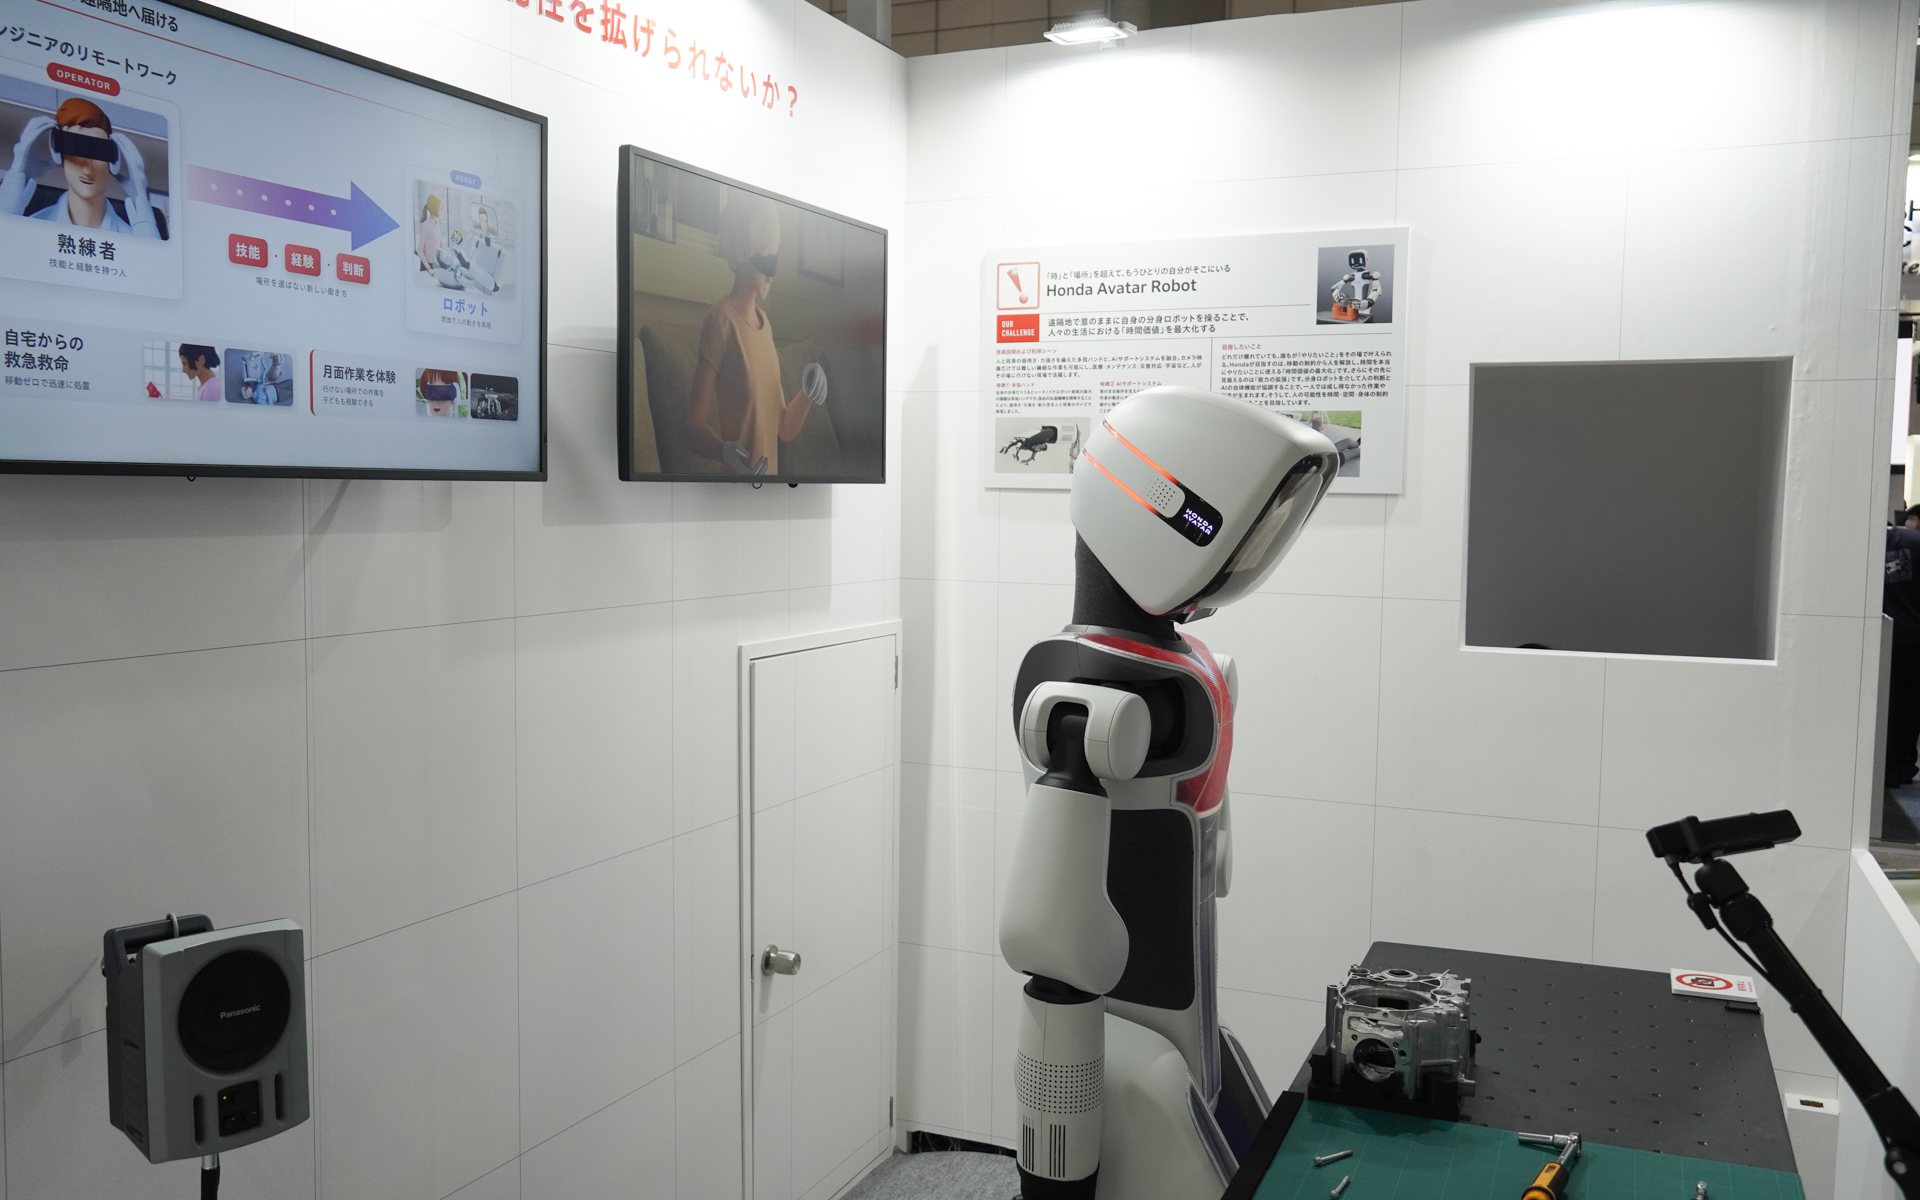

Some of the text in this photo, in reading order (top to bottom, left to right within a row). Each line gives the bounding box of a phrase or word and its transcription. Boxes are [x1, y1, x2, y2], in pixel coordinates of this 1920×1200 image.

[56, 69, 111, 91] OPERATOR
[455, 174, 477, 185] ROBOT
[57, 233, 117, 261] 熟練者
[49, 258, 127, 277] 技能と経験を持つ人
[235, 242, 364, 278] 技能 経験 判断
[1047, 264, 1231, 280] 「時」と「場所」を超えて、もうひとりの自分がそこにいる
[255, 276, 348, 298] 場所を選ばない新しい働き方
[1046, 278, 1197, 297] Honda Avatar Robot
[443, 298, 488, 317] ロボット
[1002, 320, 1014, 328] OUR
[1048, 312, 1249, 327] 遠隔地で意のままに自身の分身ロボットを操ることで、
[5, 329, 84, 351] 自宅からの
[1002, 328, 1035, 337] CHALLENGE
[1048, 324, 1217, 338] 人々の生活における「時間価値」を最大化する
[4, 351, 69, 372] 救急救命
[5, 376, 90, 391] 移動ゼロで迅速に処置
[323, 364, 396, 384] 月面作業を体験
[323, 385, 384, 397] 行けない場所での作業を
[1183, 513, 1211, 535] AVATAR
[1186, 508, 1213, 531] HONDA
[220, 1004, 261, 1020] Panasonic
